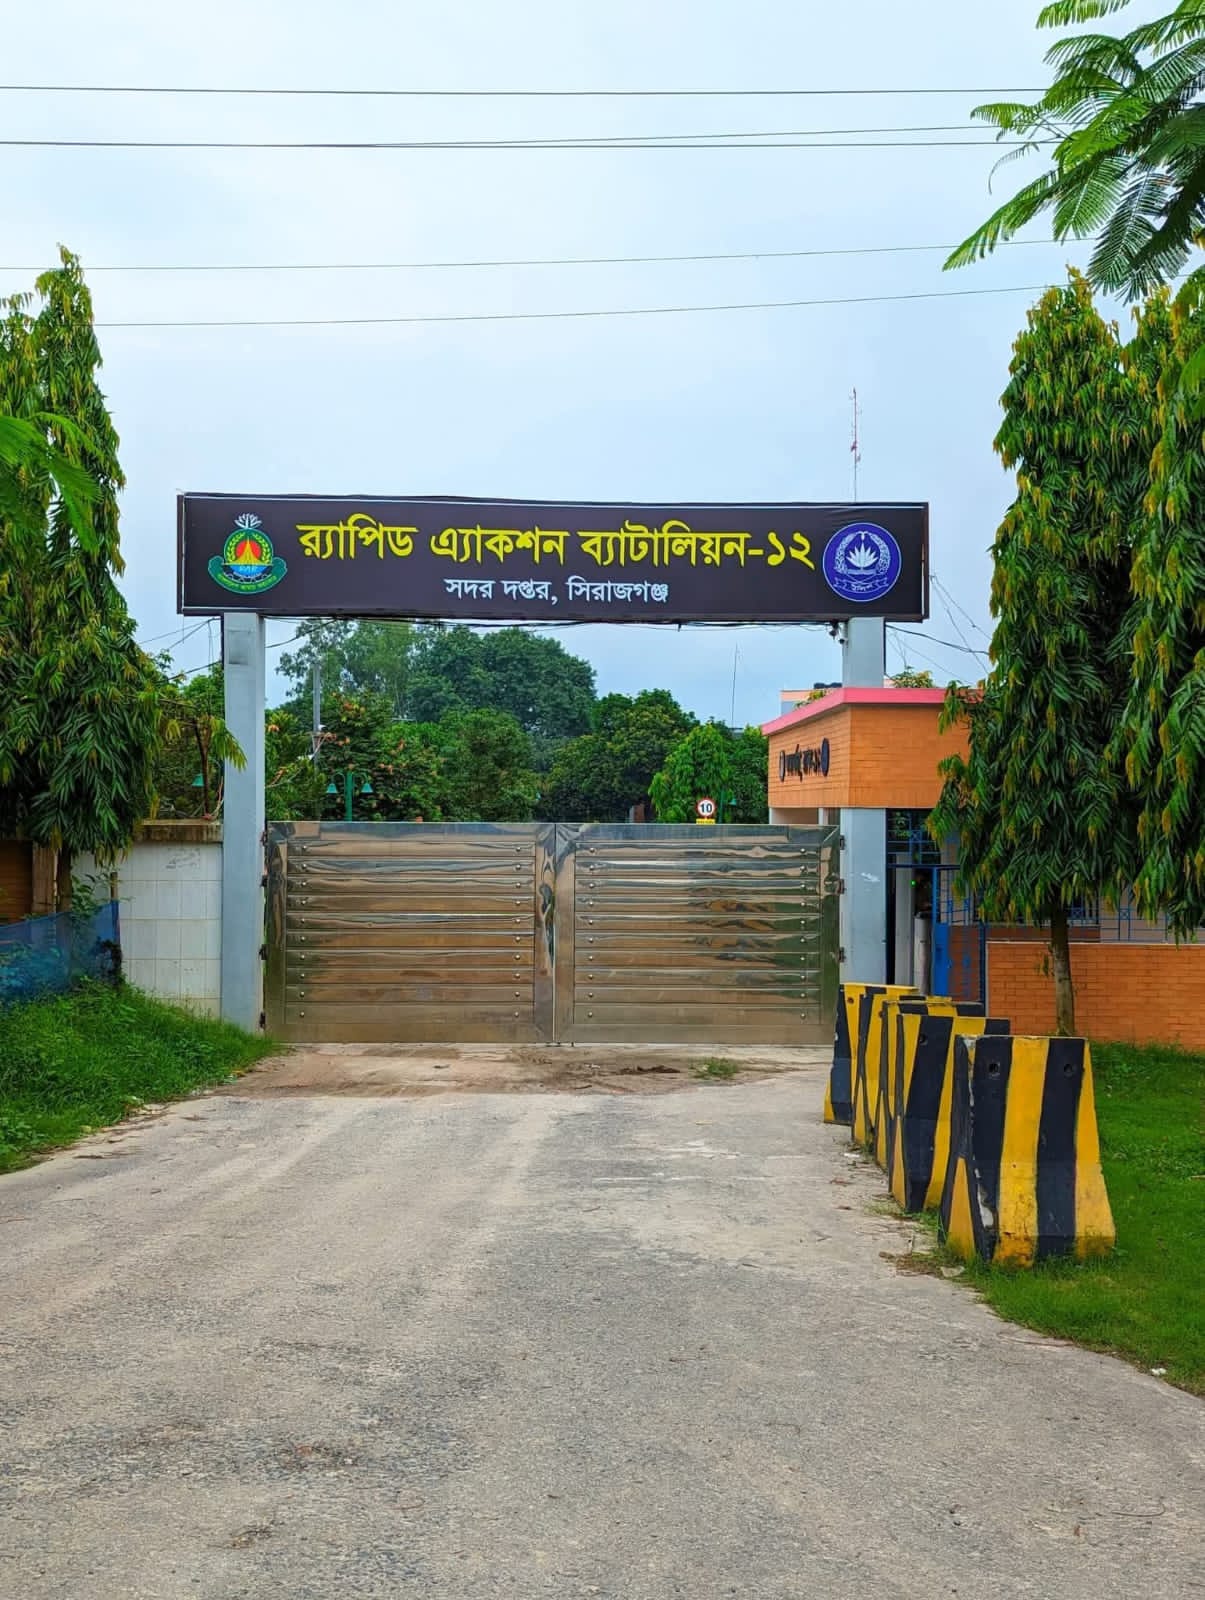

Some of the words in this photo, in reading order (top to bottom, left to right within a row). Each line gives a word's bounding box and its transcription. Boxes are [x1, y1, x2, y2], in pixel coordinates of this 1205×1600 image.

[430, 525, 569, 563] এ্যাকশন
[577, 519, 815, 570] ব্যাটালিয়ন-১২
[443, 578, 496, 600] সদর
[501, 579, 558, 605] দপ্তর,
[566, 575, 669, 603] সিরাজগঞ্জ
[700, 803, 713, 813] 10
